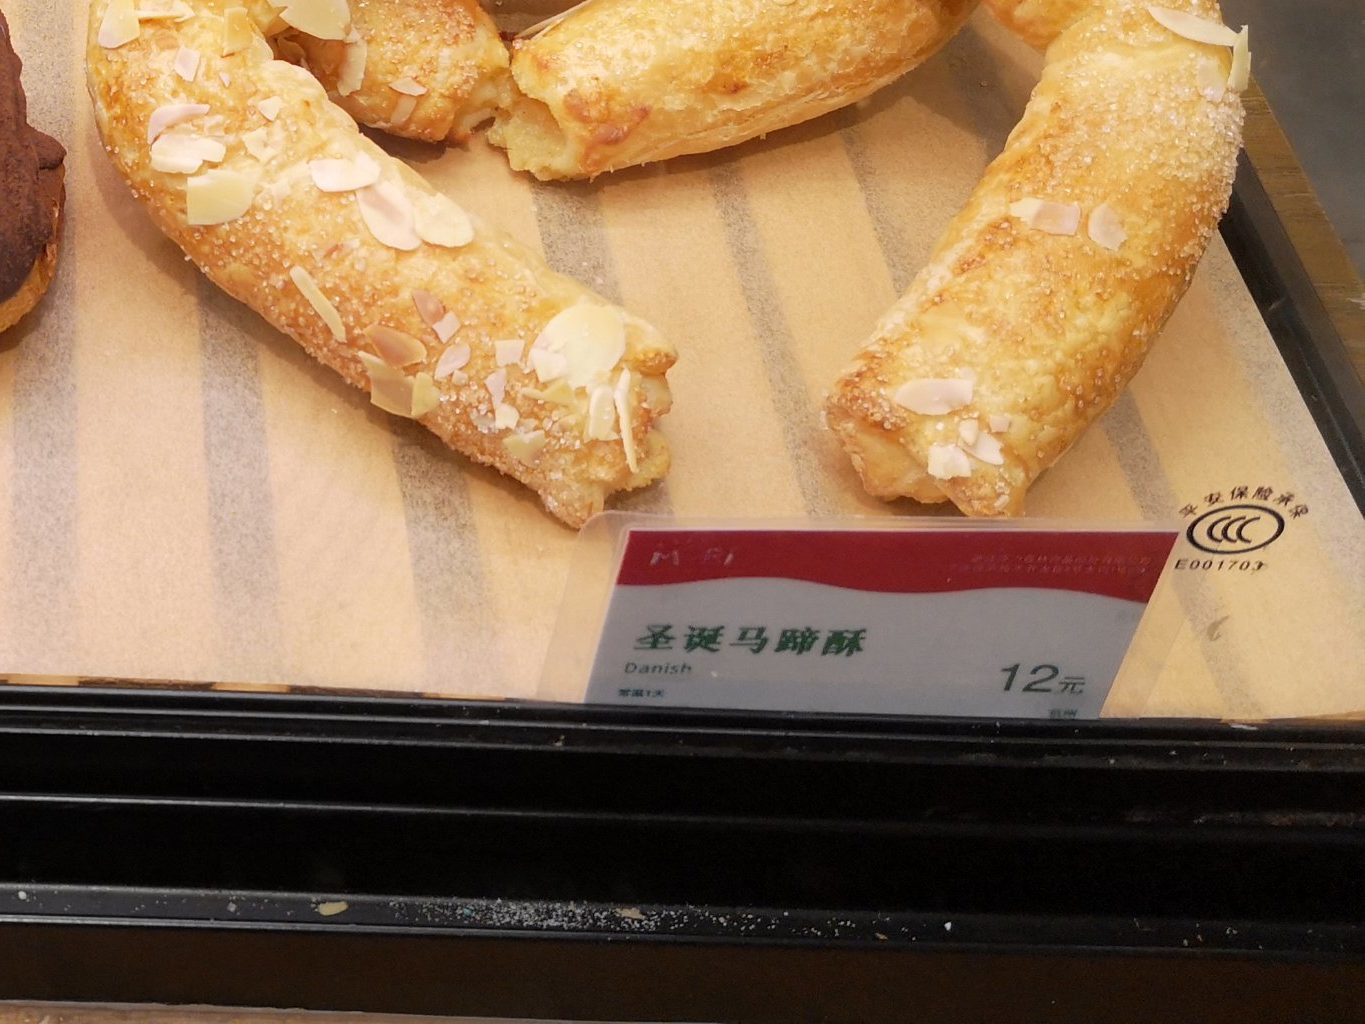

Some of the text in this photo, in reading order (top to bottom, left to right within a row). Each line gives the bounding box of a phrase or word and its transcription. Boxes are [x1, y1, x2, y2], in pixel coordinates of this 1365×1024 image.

[634, 624, 868, 658] 圣诞马蹄酥
[624, 662, 693, 675] Danish
